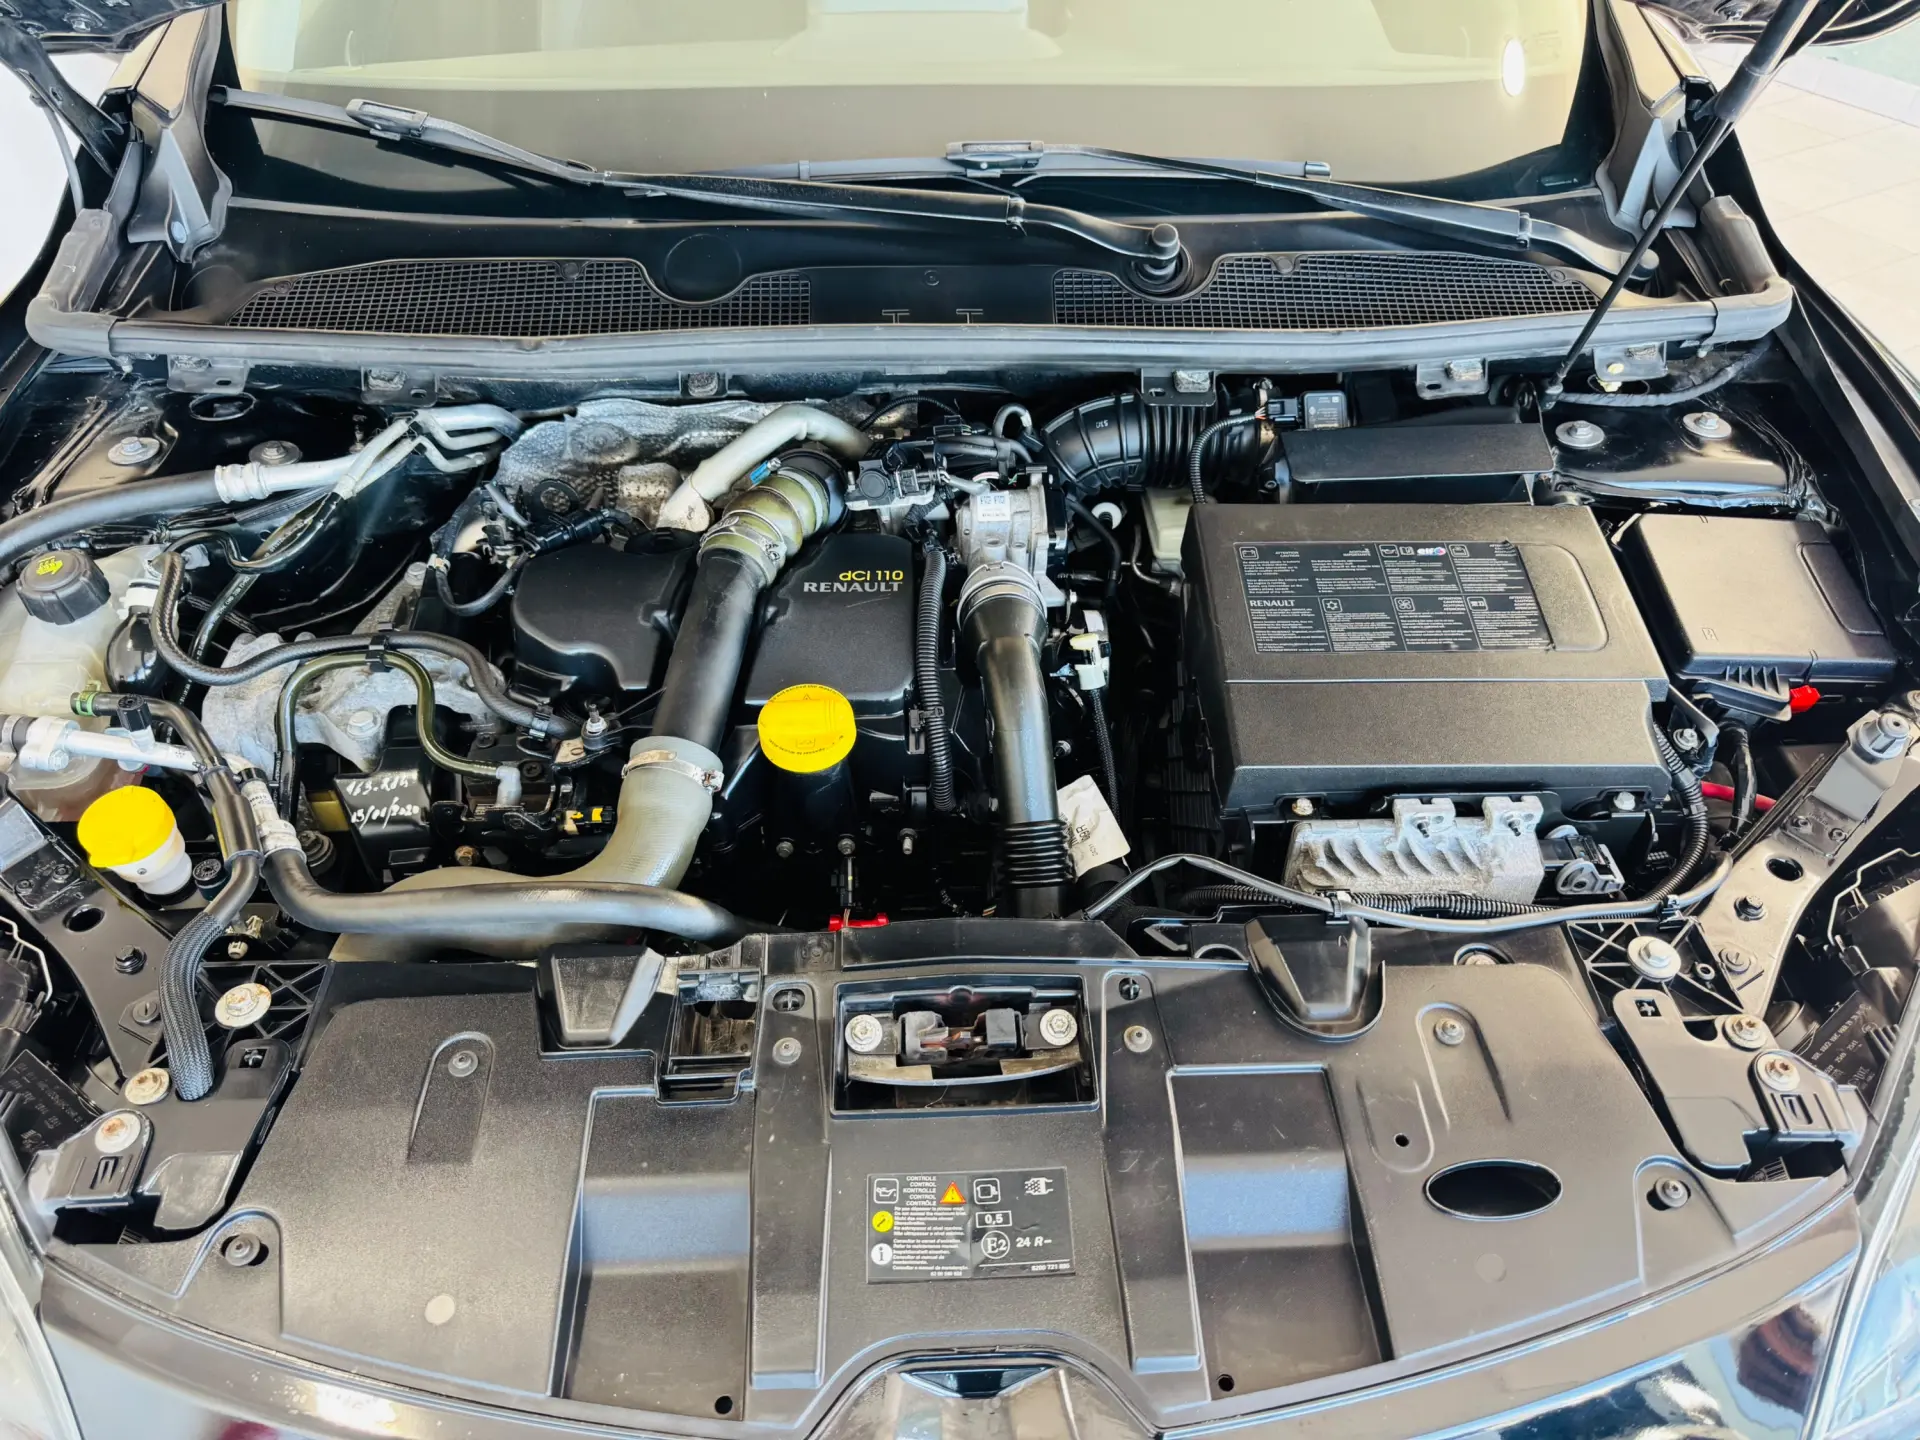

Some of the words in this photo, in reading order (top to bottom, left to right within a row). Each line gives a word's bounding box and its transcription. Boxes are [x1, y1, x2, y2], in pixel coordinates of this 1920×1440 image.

[875, 570, 904, 581] 110
[803, 582, 903, 592] RENAULT
[985, 1214, 1003, 1225] 0,5
[986, 1237, 1007, 1253] E2
[1016, 1237, 1031, 1247] 24
